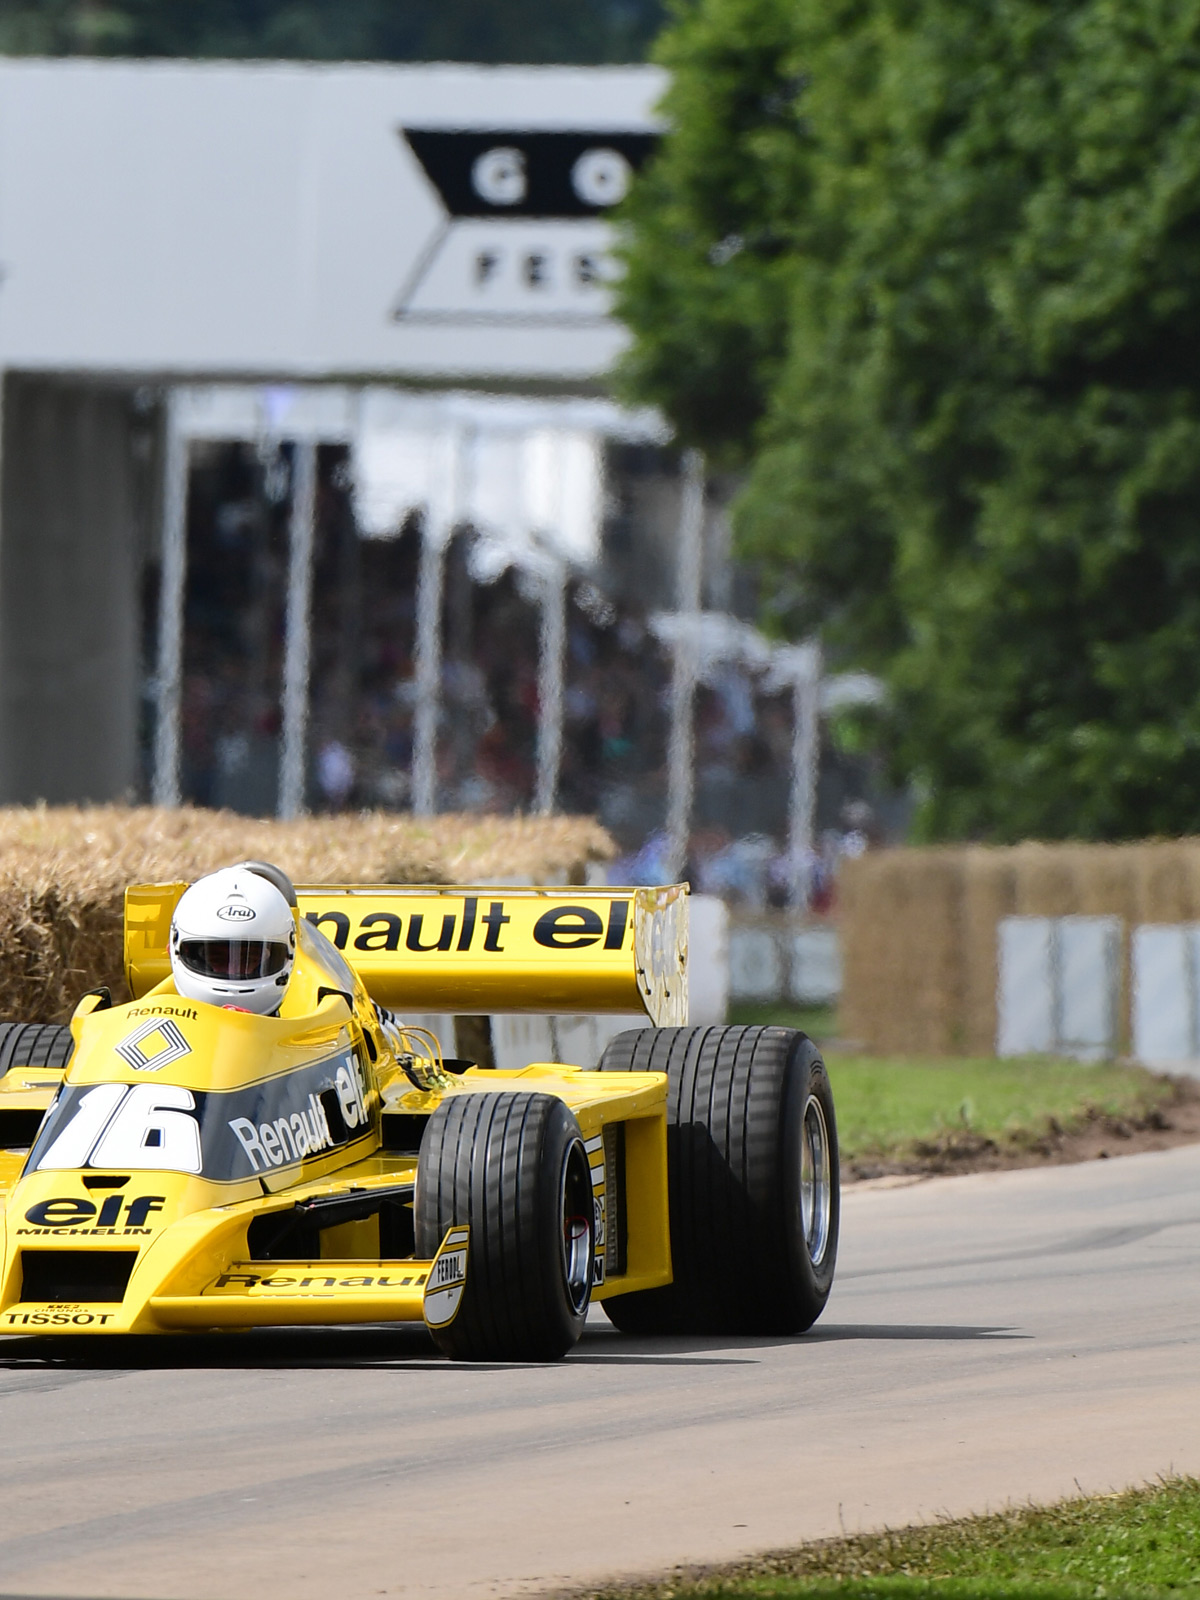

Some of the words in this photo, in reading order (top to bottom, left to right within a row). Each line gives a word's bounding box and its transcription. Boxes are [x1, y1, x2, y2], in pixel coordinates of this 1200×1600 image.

[532, 900, 635, 951] el
[127, 1005, 199, 1021] Renault
[335, 1053, 369, 1129] elf
[36, 1083, 203, 1175] 16
[24, 1194, 167, 1228] elf
[15, 1228, 153, 1236] MICHELIN
[213, 1272, 428, 1288] Renaul
[5, 1313, 115, 1325] TISSOT
